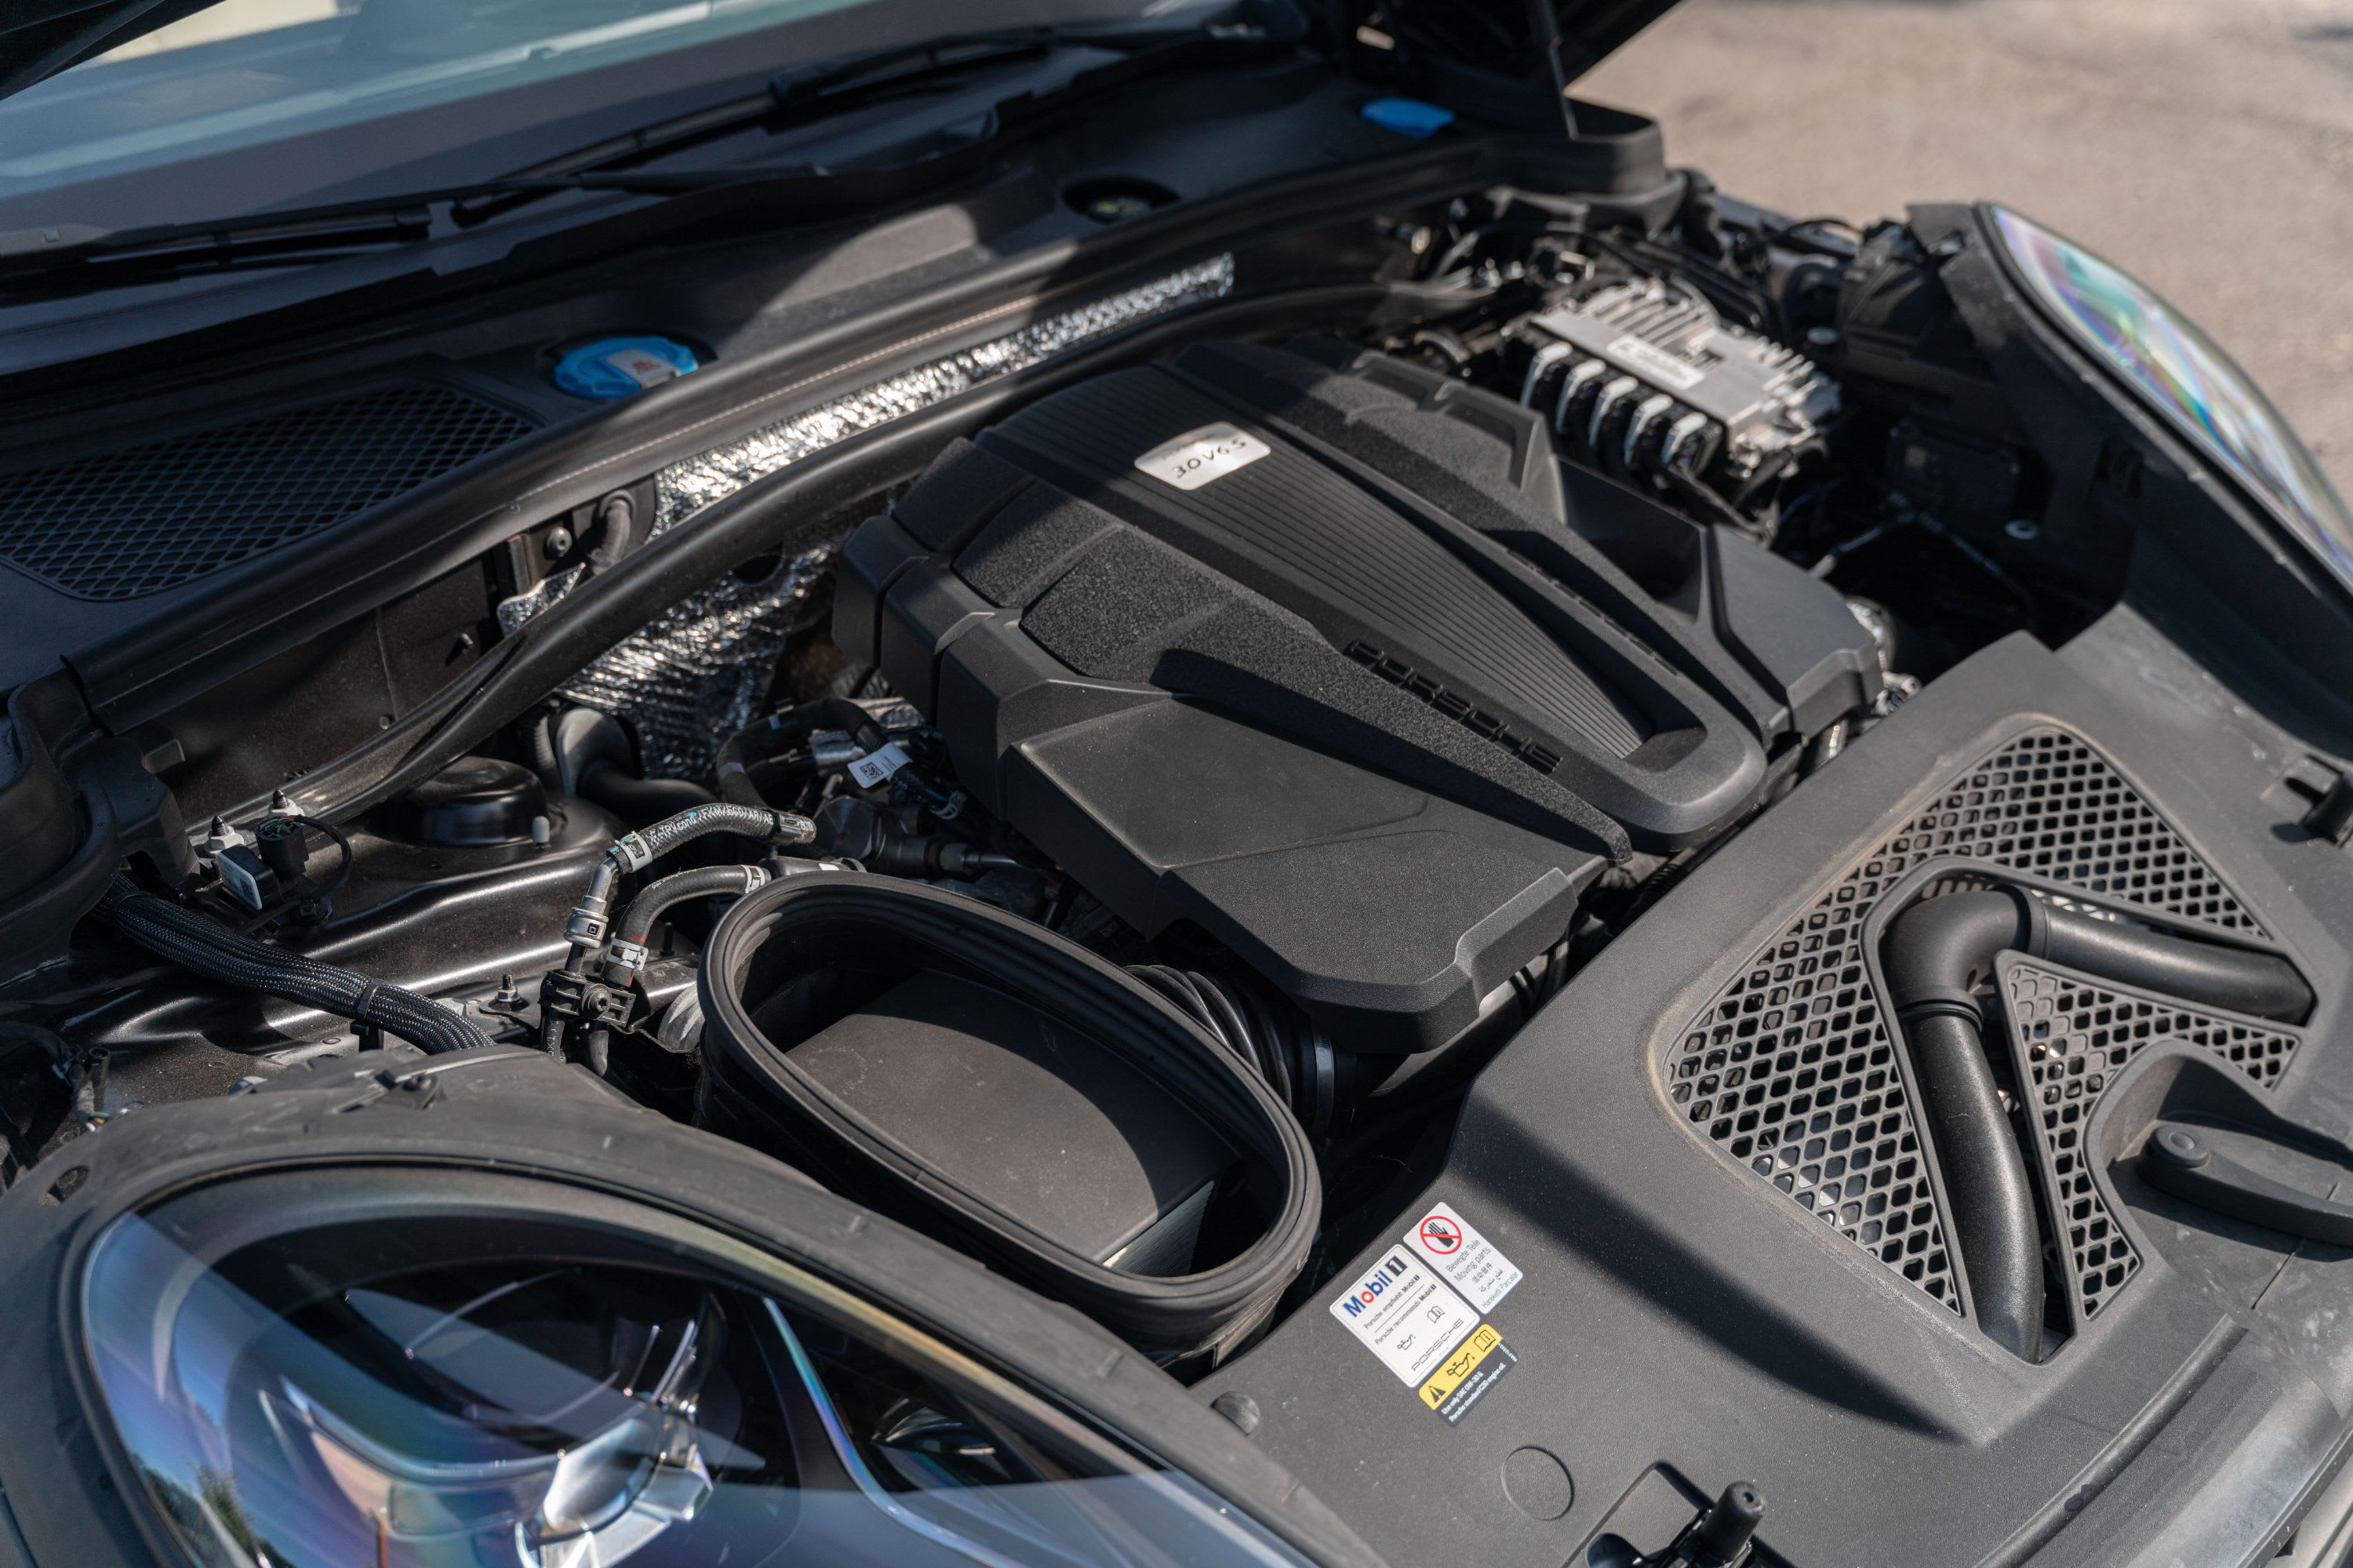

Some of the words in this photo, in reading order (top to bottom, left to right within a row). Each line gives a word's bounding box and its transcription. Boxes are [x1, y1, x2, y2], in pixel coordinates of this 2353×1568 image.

[1342, 640, 1562, 774] PORSCHE
[1446, 1250, 1469, 1272] Bewegte
[1467, 1239, 1480, 1251] Teile
[1453, 1261, 1478, 1281] Moving
[1475, 1247, 1490, 1264] parts
[1343, 1270, 1393, 1318] Mobil
[1386, 1257, 1405, 1275] 1
[1364, 1312, 1383, 1330] Porsche
[1375, 1327, 1394, 1344] Porsche
[1393, 1301, 1420, 1326] recommends
[1411, 1318, 1464, 1371] PORSCHE
[1441, 1405, 1451, 1414] Use
[1449, 1397, 1460, 1407] only
[1457, 1388, 1467, 1399] SAE
[1449, 1405, 1466, 1422] Porsche
[1464, 1388, 1482, 1406] standard
[1478, 1380, 1489, 1391] C30
[1487, 1369, 1500, 1382] engine
